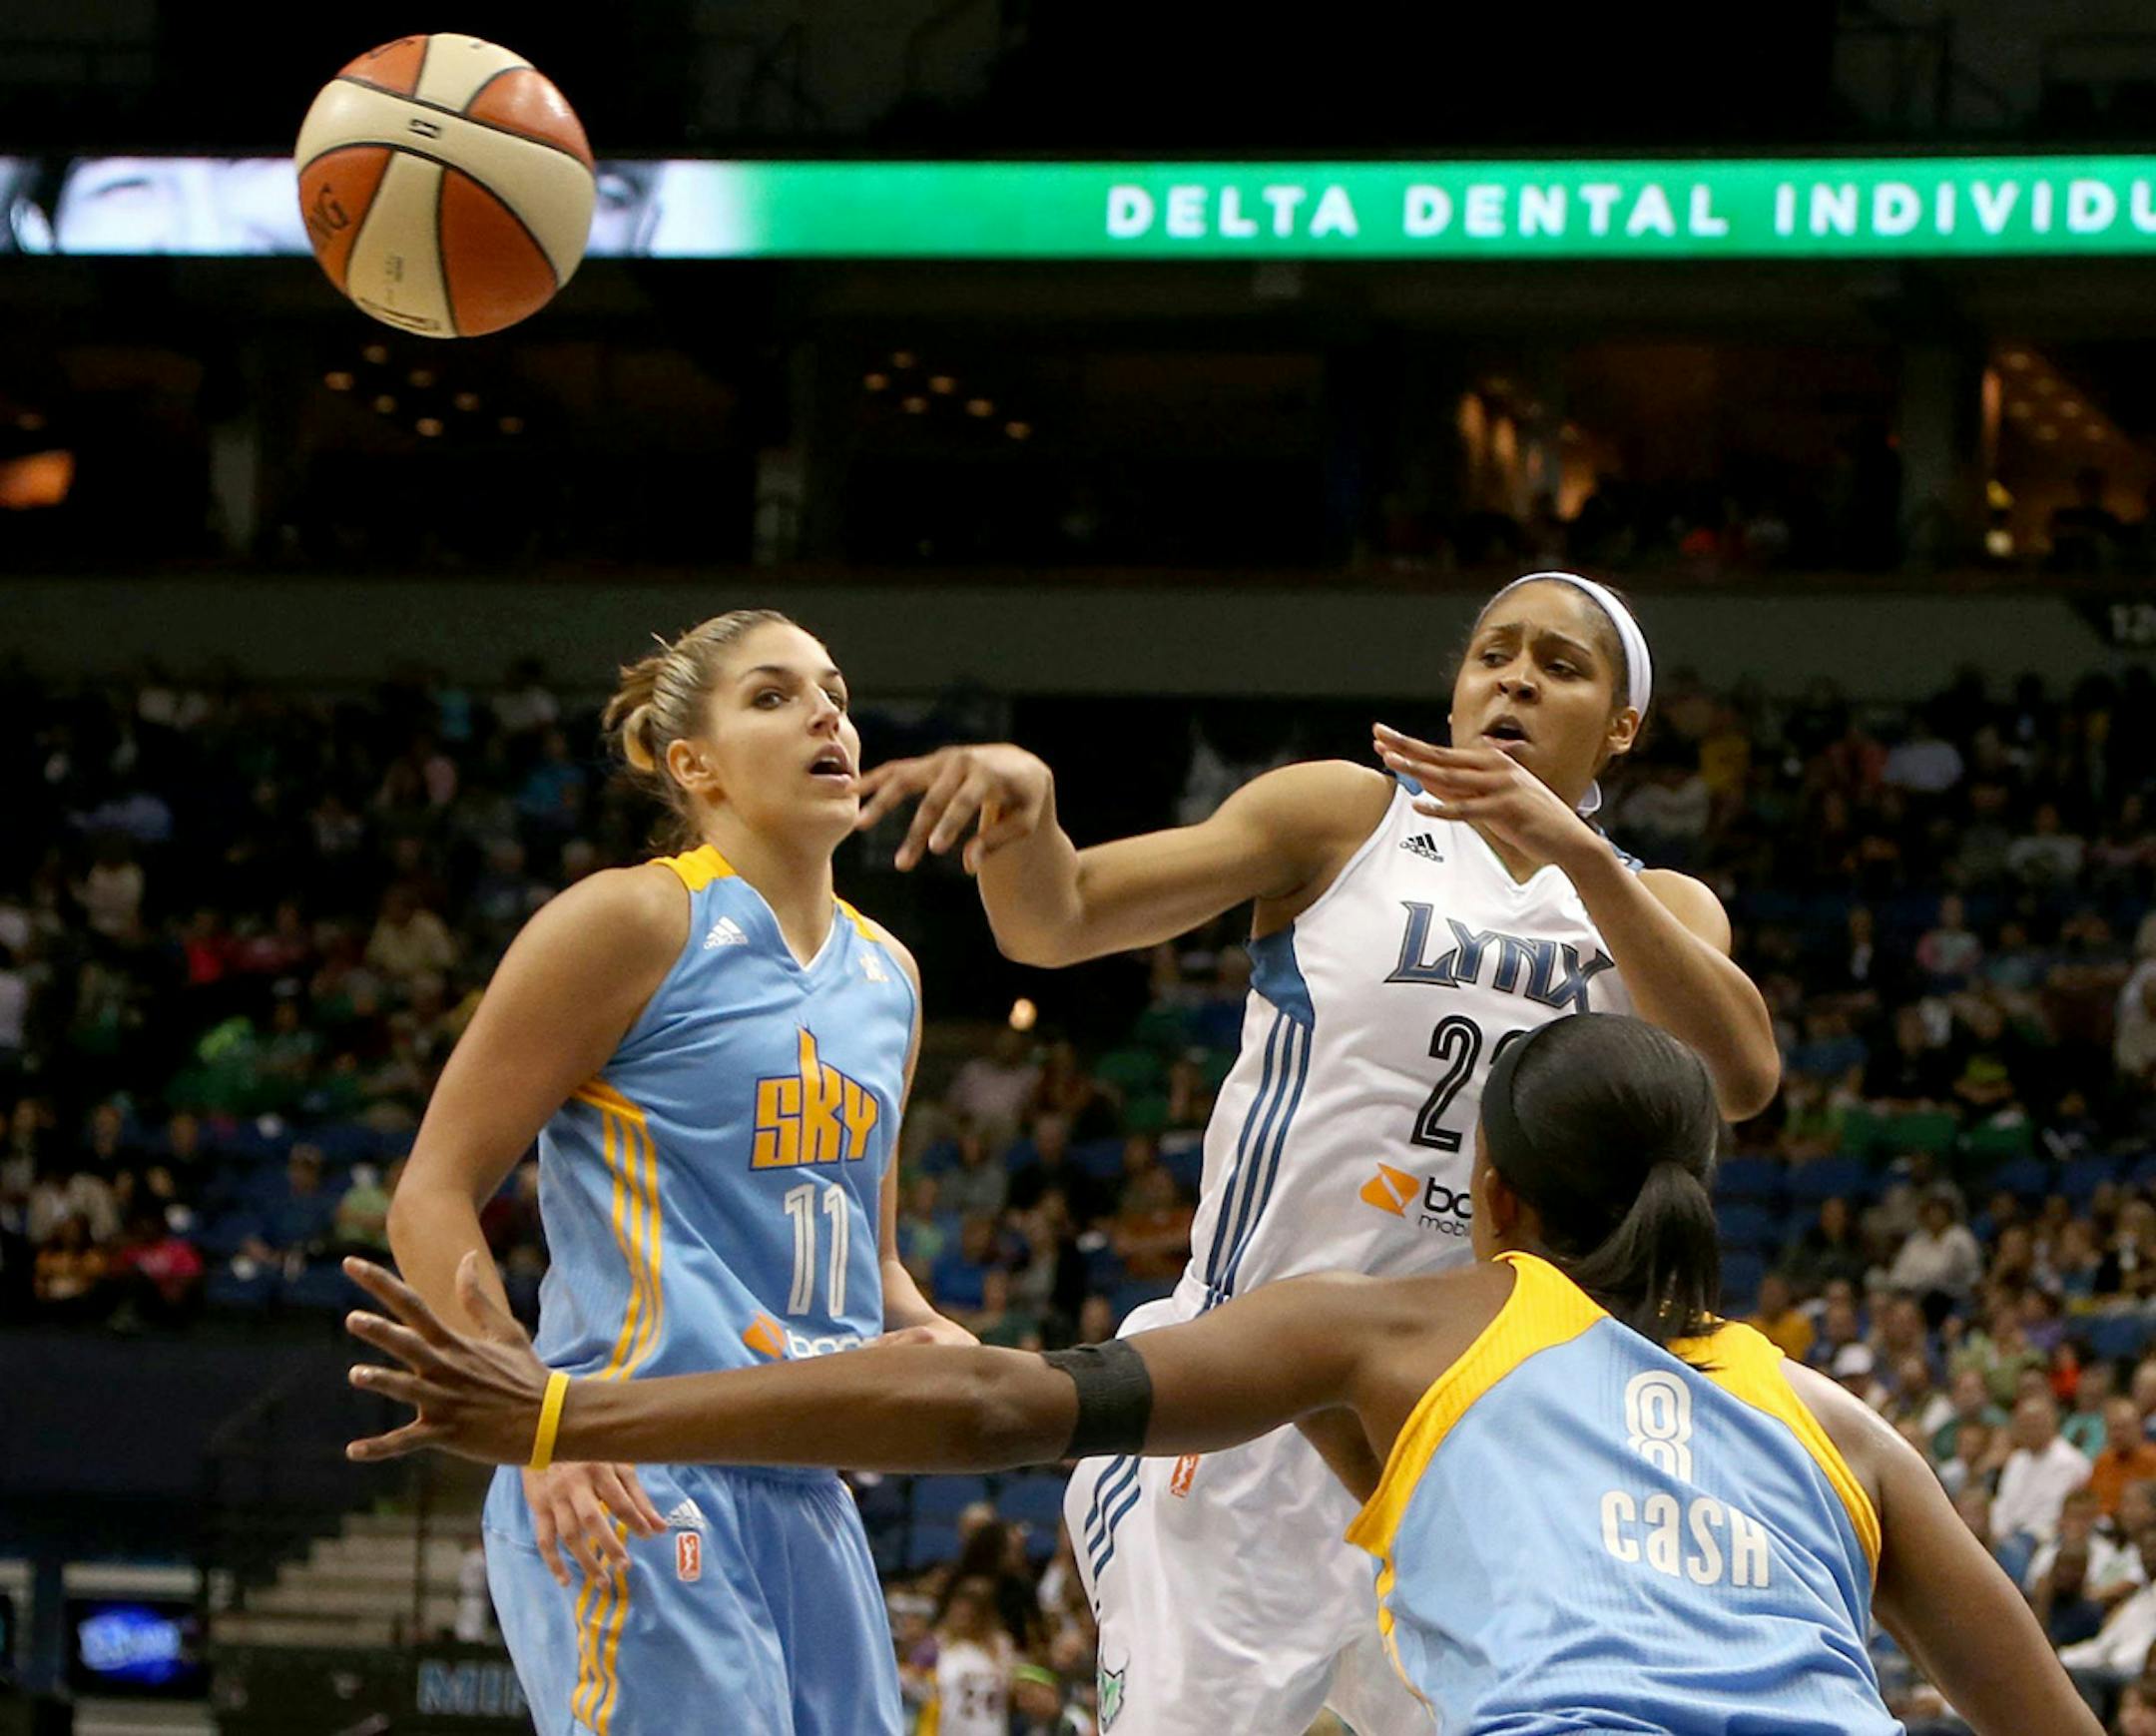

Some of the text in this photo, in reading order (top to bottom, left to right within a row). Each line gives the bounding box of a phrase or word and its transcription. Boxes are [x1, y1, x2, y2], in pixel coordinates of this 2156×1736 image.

[1106, 184, 1359, 239] DELTA
[1402, 183, 1730, 239] DENTAL
[1399, 840, 1445, 864] adidas
[749, 1024, 879, 1172] SKY
[1423, 1176, 1473, 1219] bo
[1417, 1214, 1471, 1237] mob
[785, 1183, 849, 1319] 11
[786, 1329, 876, 1359] boo
[1624, 1369, 1693, 1484] 8
